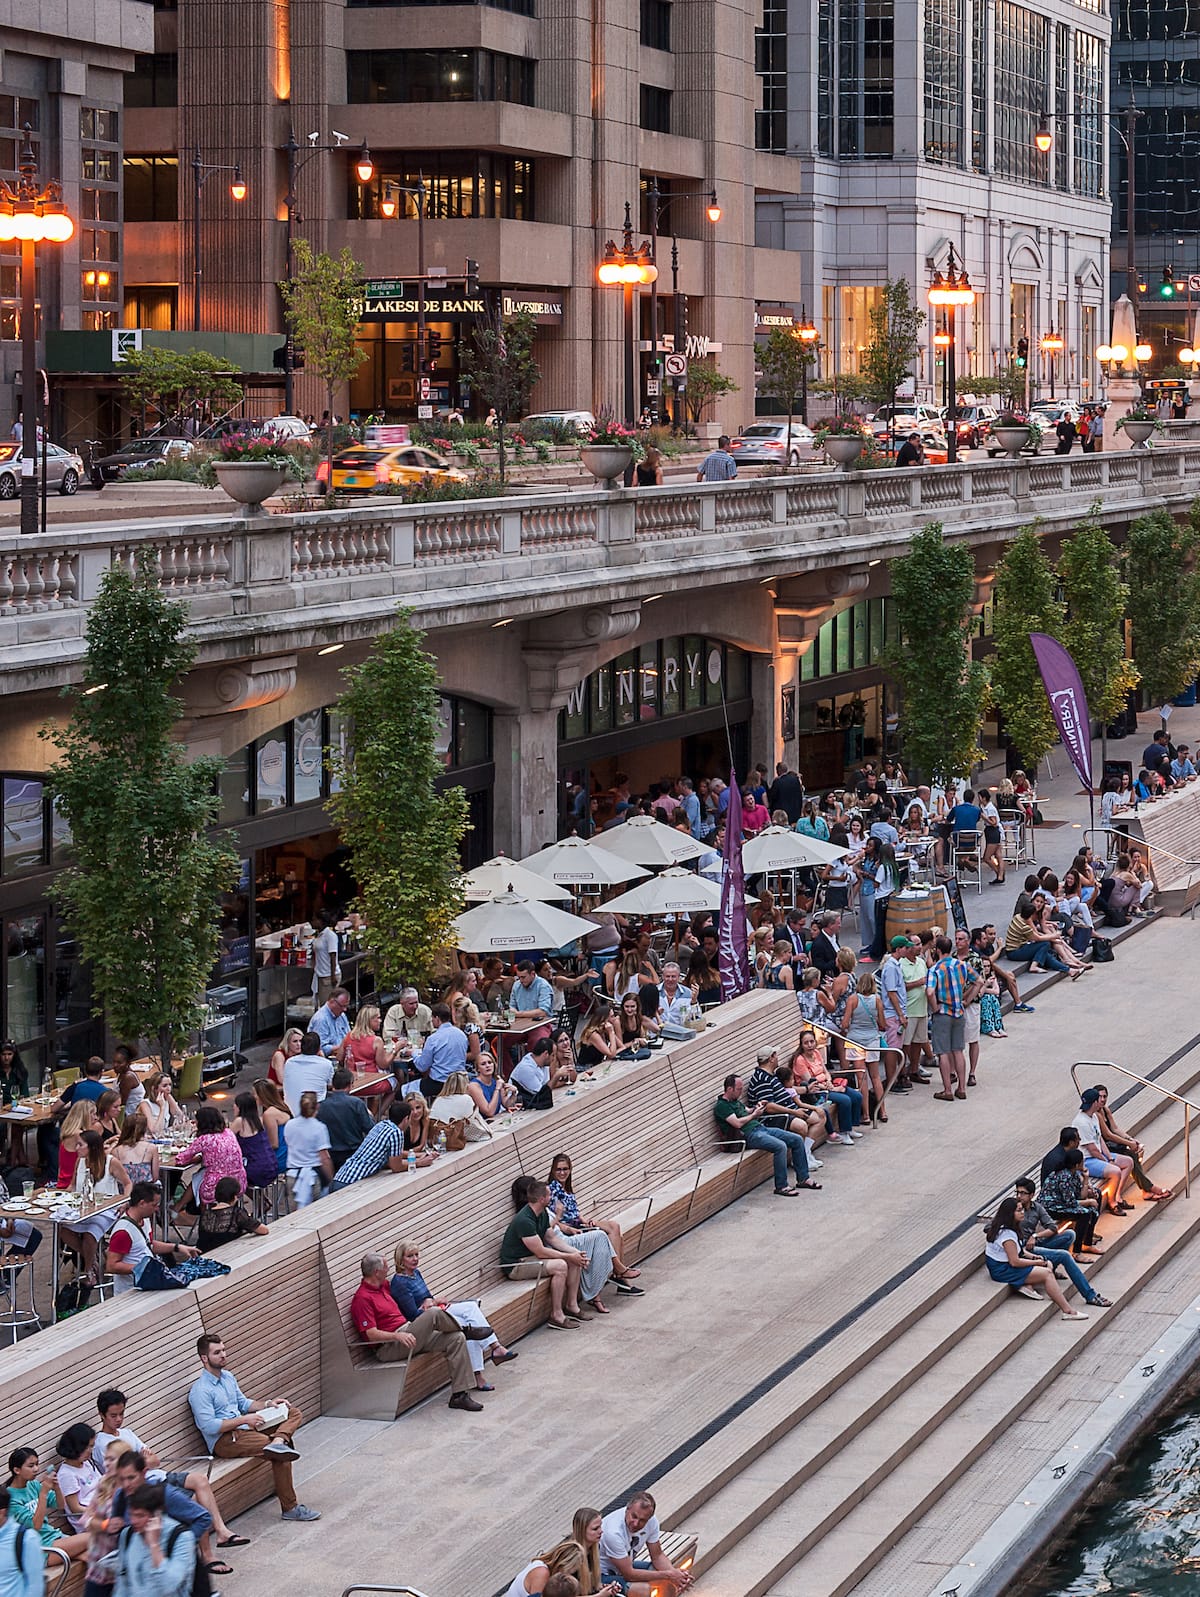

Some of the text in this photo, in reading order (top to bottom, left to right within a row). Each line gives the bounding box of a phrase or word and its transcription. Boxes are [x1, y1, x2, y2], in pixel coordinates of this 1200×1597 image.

[365, 300, 485, 313] LAKESIDE BANK
[544, 303, 562, 314] BANK
[567, 652, 699, 717] WINERY
